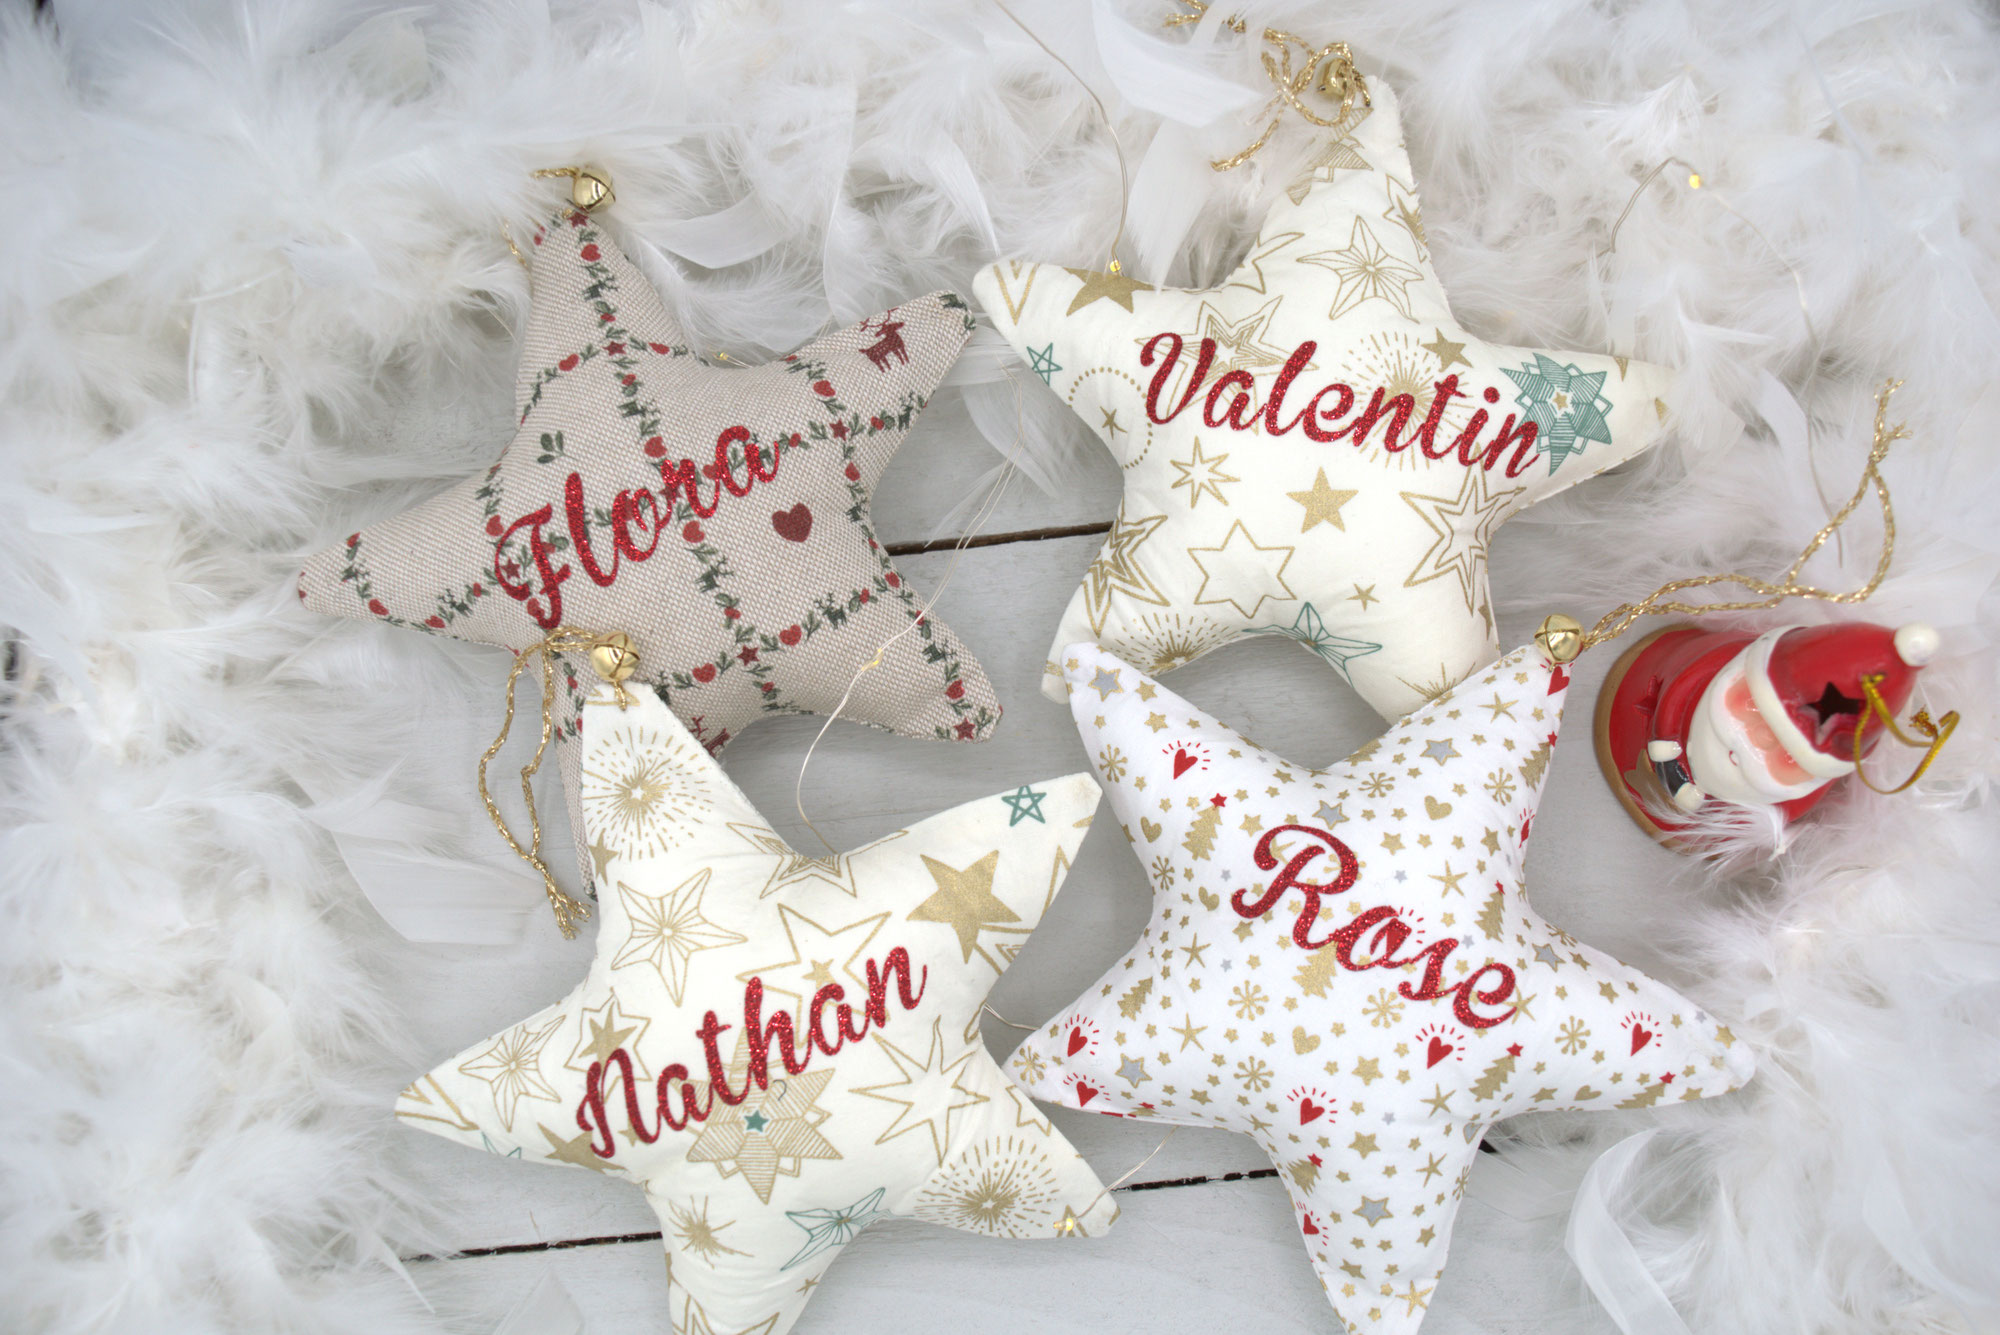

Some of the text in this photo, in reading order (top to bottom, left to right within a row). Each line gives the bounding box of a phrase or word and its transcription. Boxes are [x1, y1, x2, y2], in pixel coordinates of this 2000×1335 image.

[1140, 332, 1540, 478] Valentin
[495, 425, 780, 630] Flora
[1231, 824, 1518, 1029] Rose
[576, 946, 927, 1159] Nathan
